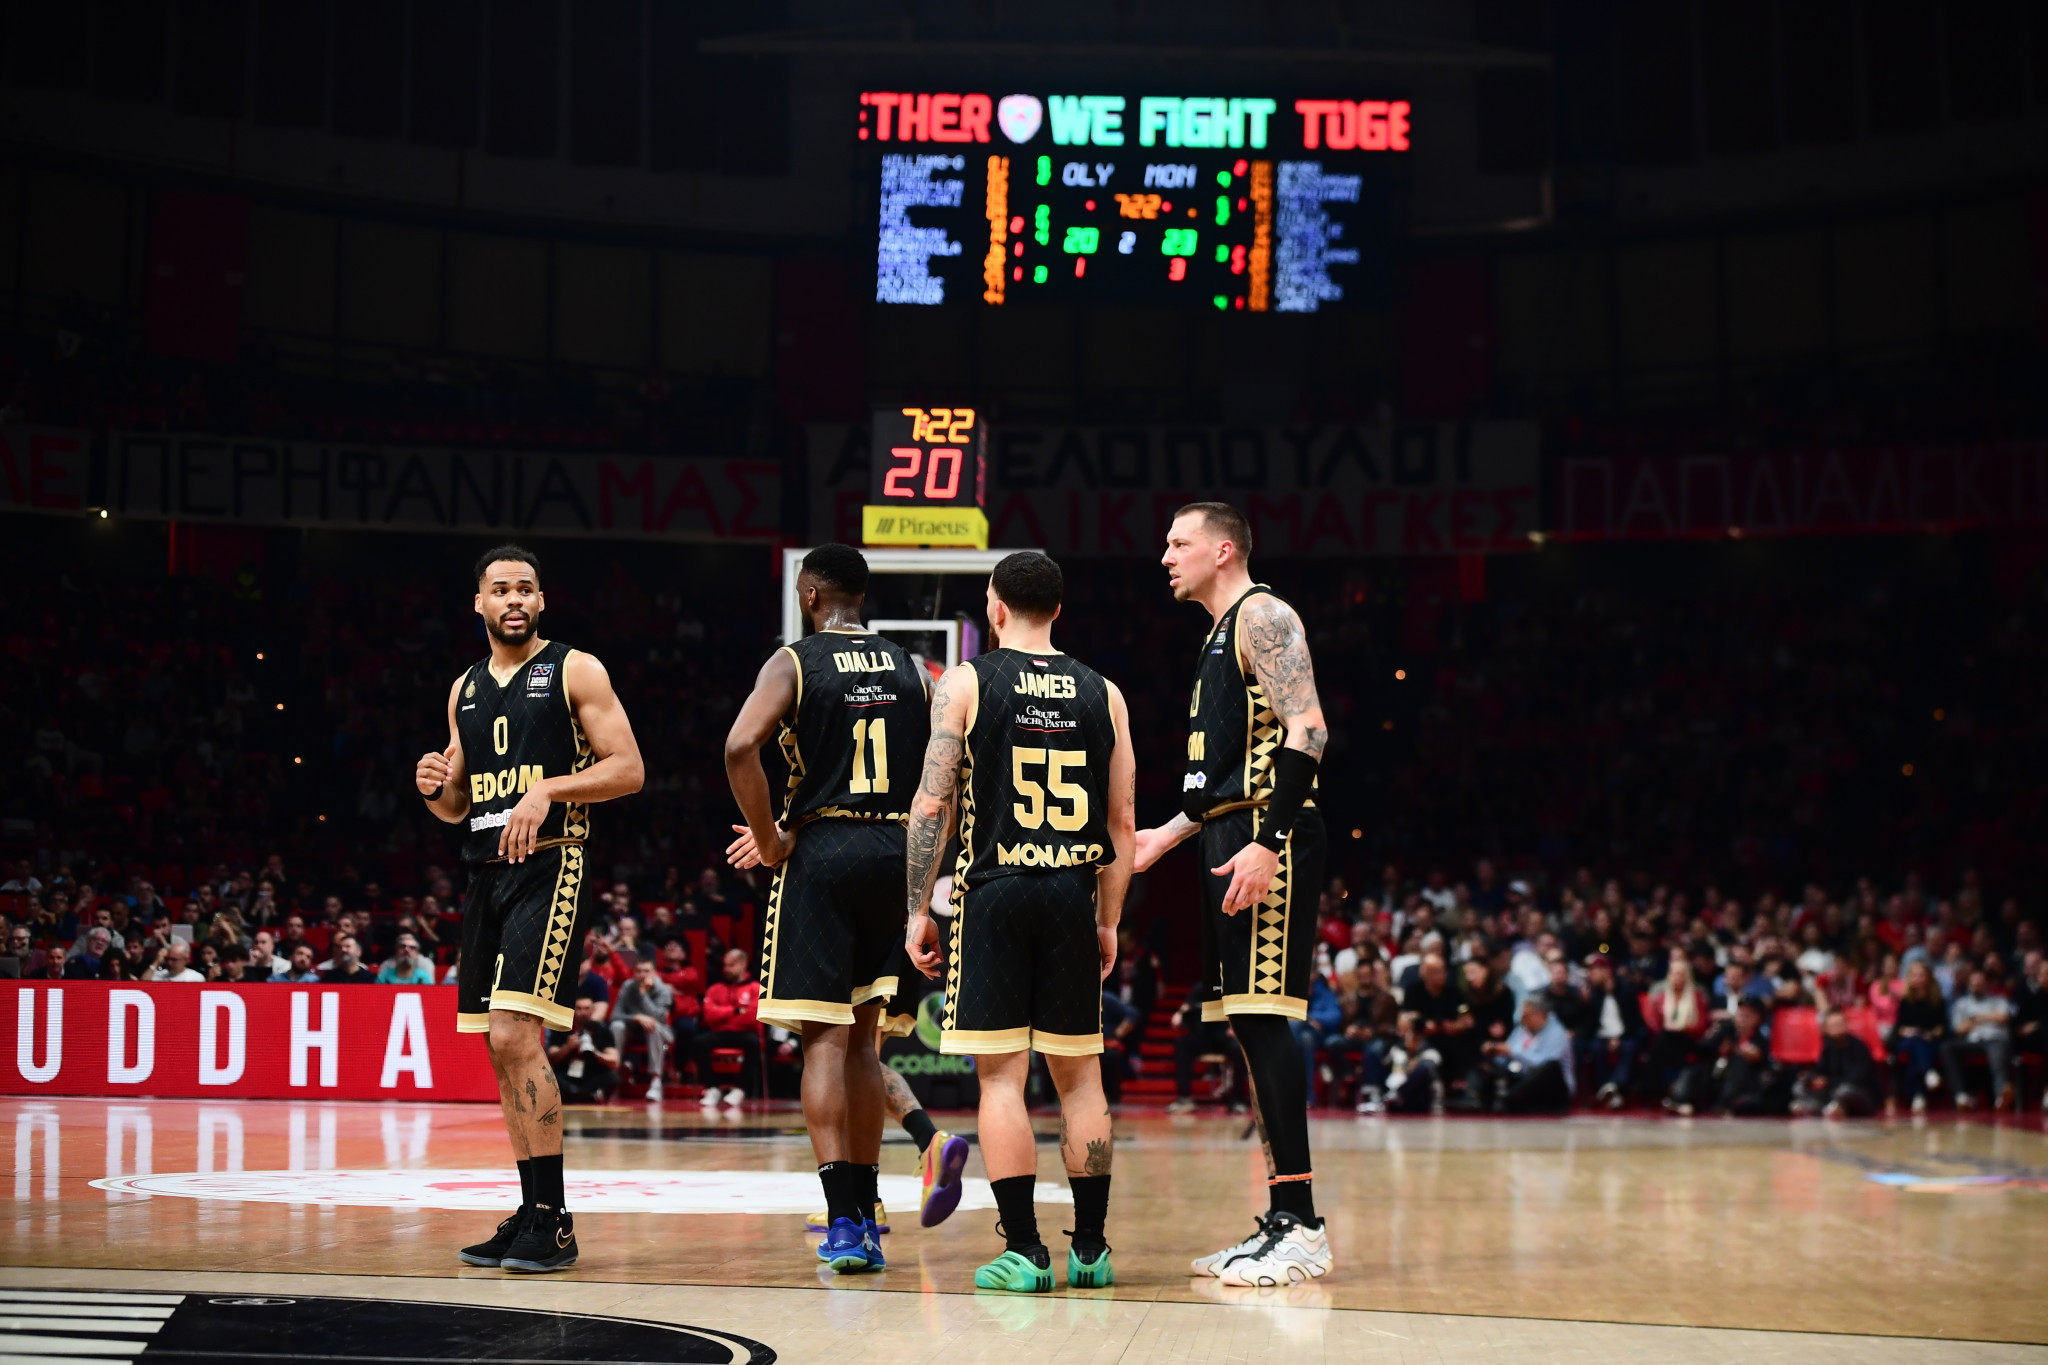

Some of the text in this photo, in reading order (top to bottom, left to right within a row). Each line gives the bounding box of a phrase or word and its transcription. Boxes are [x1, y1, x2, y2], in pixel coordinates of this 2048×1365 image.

[859, 92, 993, 143] THER
[1048, 95, 1126, 146] WE
[1139, 96, 1277, 149] FIGHT
[1062, 162, 1115, 187] OLY
[1063, 227, 1100, 254] 20
[902, 408, 976, 443] 7:22
[883, 447, 963, 499] 20
[600, 461, 781, 538] ΜΑΣ
[899, 518, 970, 536] Piraeus
[833, 651, 895, 673] DIALLO
[1014, 671, 1077, 699] JAMES
[493, 715, 509, 756] 0
[1044, 718, 1077, 728] PASTOR
[849, 717, 890, 794] 11
[1012, 745, 1089, 832] 55
